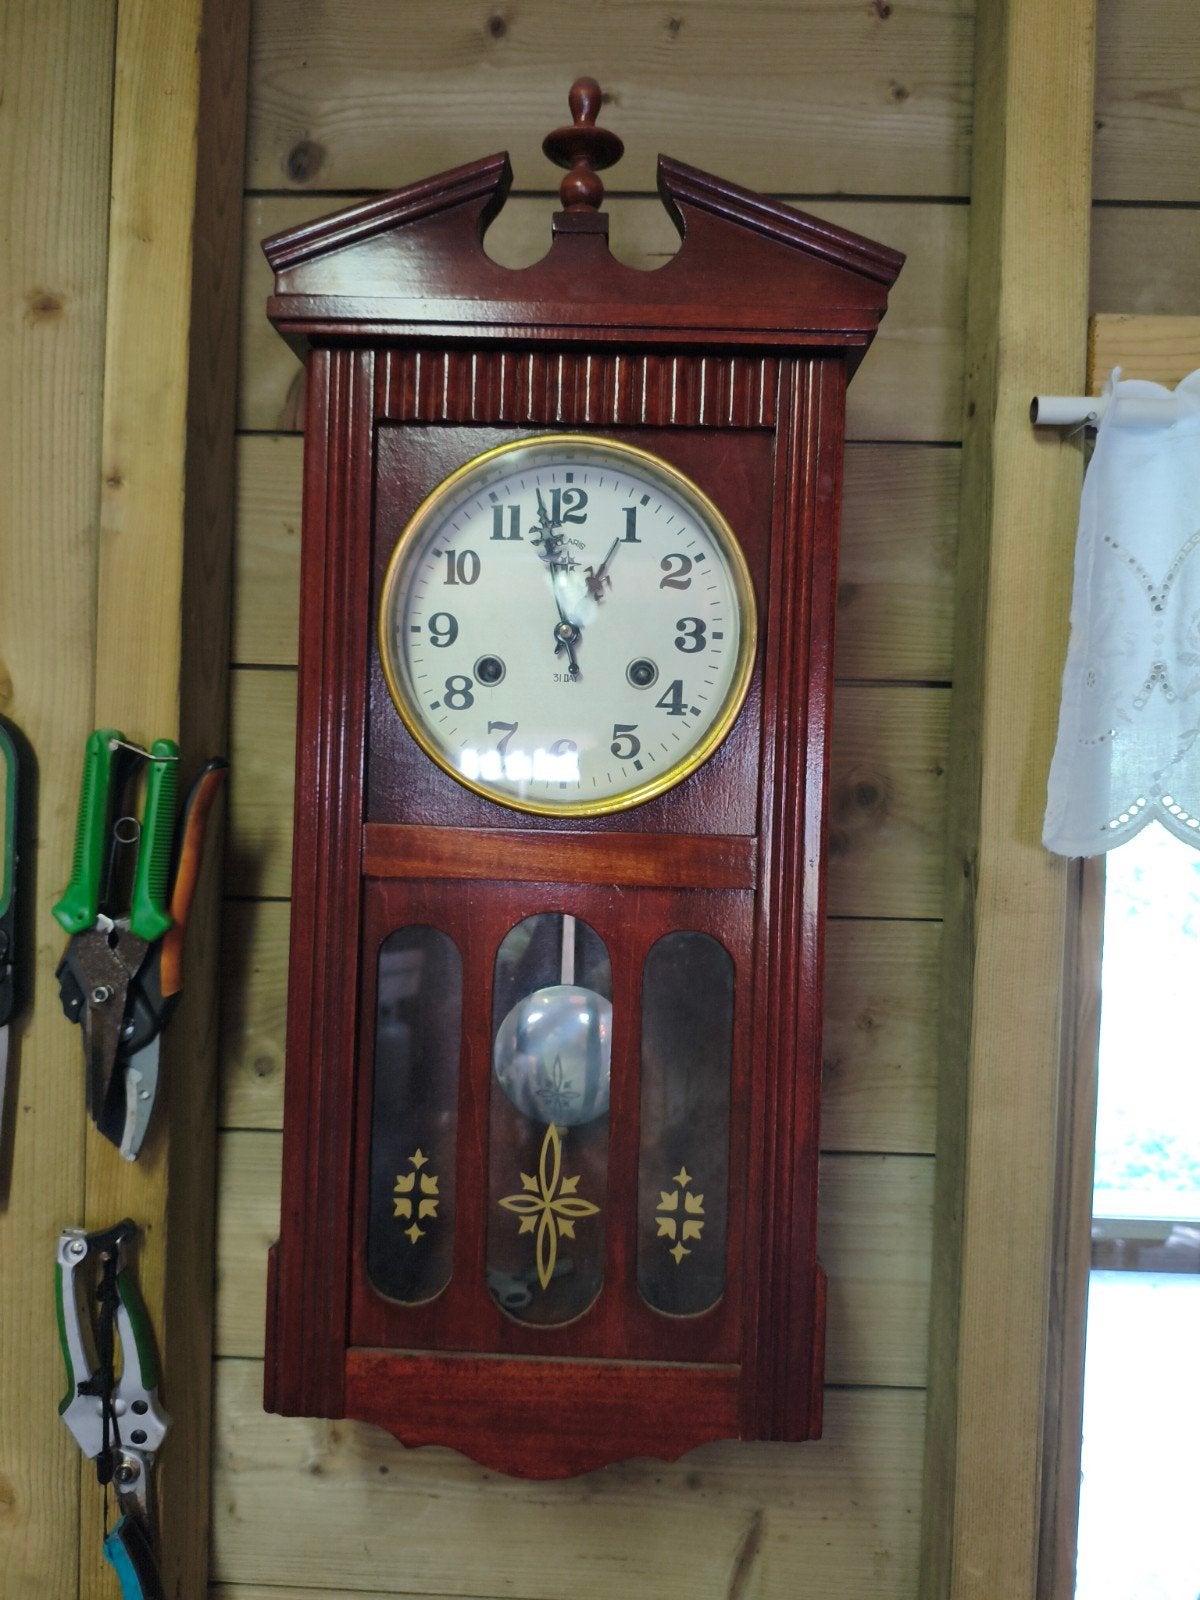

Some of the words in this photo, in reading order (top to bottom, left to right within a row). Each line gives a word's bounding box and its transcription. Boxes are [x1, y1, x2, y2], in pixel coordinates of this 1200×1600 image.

[490, 504, 523, 540] 11
[550, 488, 588, 525] 12
[620, 505, 642, 543] 1
[443, 549, 481, 585] 10
[660, 553, 692, 590] 2
[428, 612, 458, 647] 9
[674, 617, 706, 653] 3
[444, 675, 474, 710] 8
[553, 673, 562, 682] 31
[655, 679, 688, 716] 4
[487, 721, 518, 756] 7
[611, 724, 640, 759] 5
